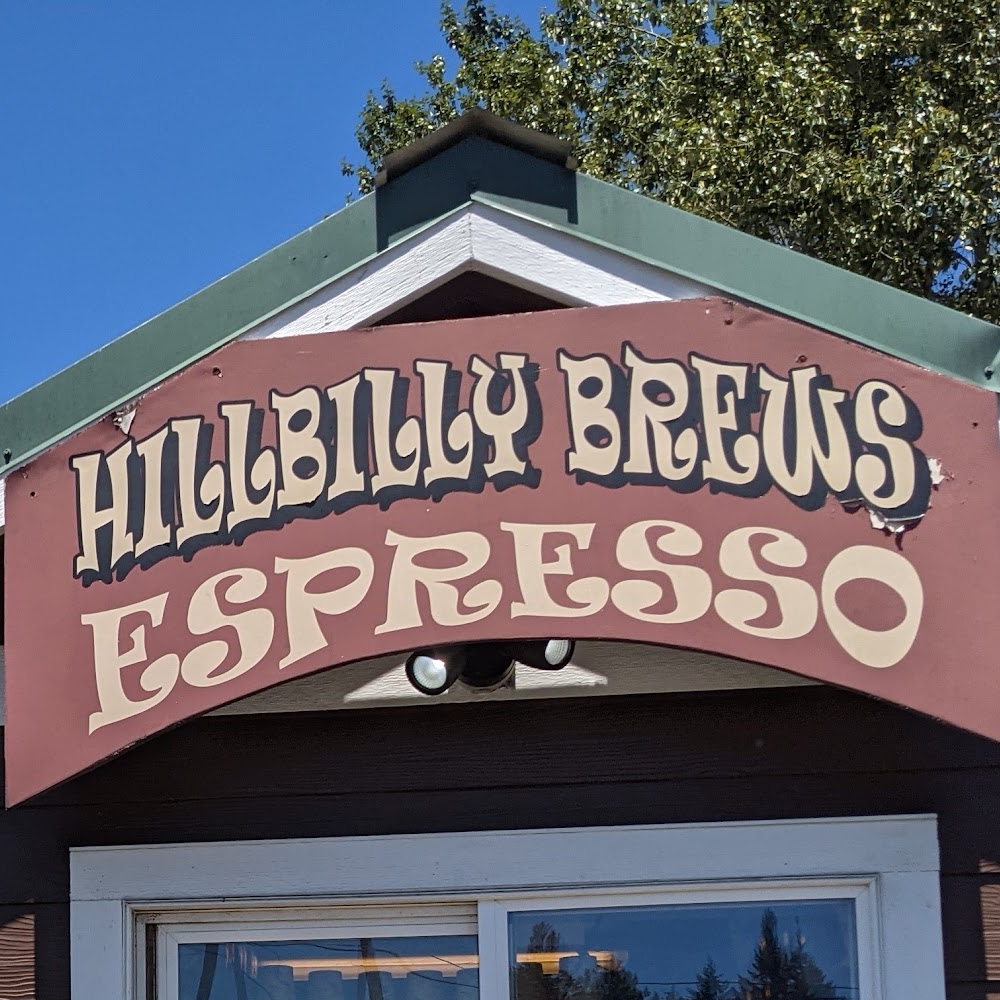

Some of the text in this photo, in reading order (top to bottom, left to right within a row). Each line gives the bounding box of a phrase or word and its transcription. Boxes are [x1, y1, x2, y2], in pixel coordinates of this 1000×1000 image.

[72, 343, 930, 583] HILLBILLY BREWS
[80, 520, 924, 736] ESPRESSO
